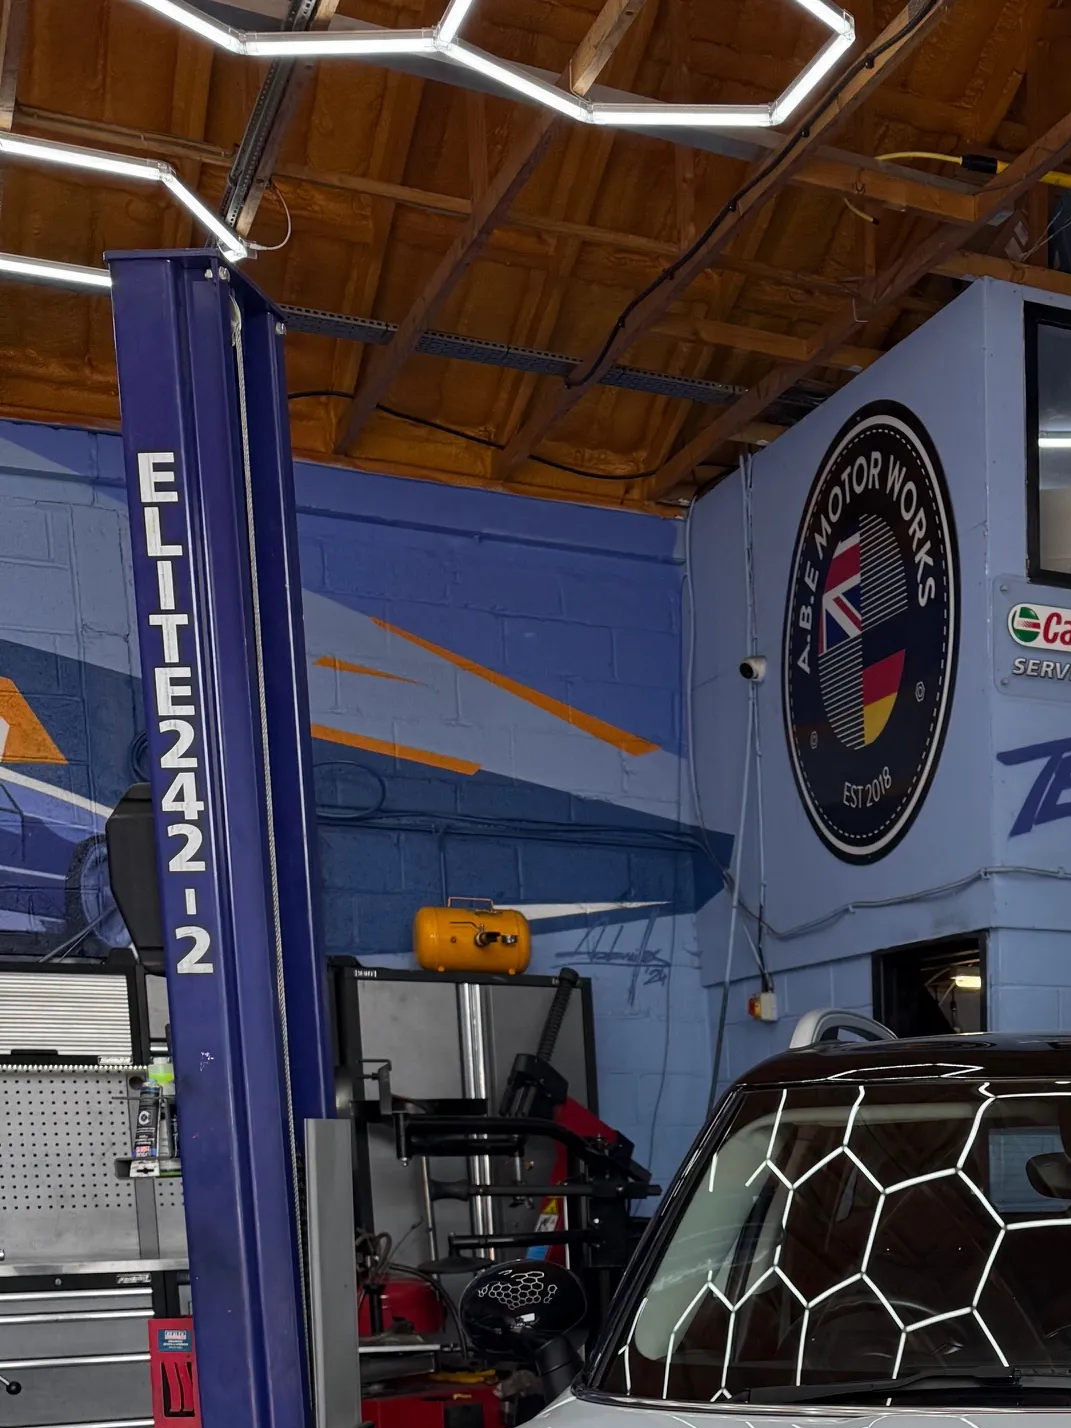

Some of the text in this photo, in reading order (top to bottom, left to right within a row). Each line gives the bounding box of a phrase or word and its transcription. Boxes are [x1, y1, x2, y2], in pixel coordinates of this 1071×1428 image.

[797, 451, 936, 675] A.B.E MOTOR WORKS
[843, 766, 892, 808] EST 2018
